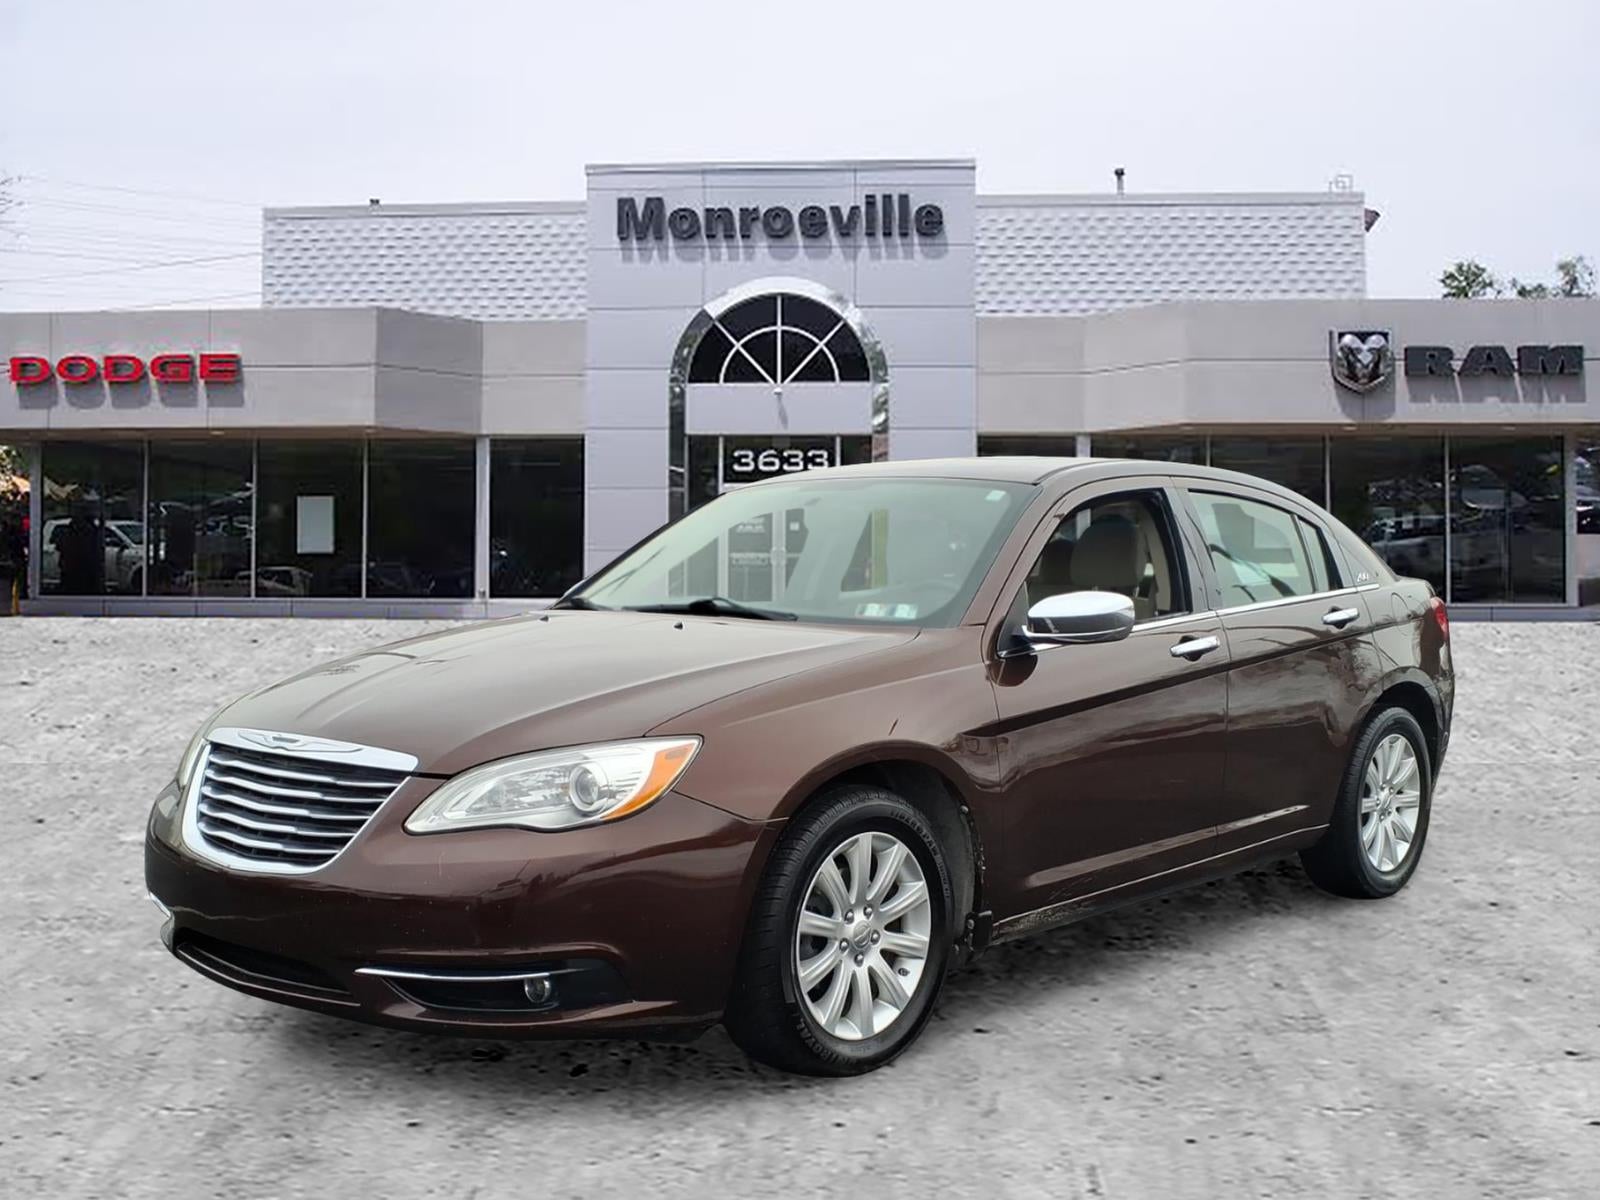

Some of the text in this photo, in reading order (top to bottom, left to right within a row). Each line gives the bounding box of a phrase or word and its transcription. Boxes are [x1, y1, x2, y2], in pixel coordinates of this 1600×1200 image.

[617, 193, 943, 241] Monroeville
[9, 353, 241, 383] DODGE
[1404, 345, 1584, 377] RAM
[732, 449, 828, 472] 3633
